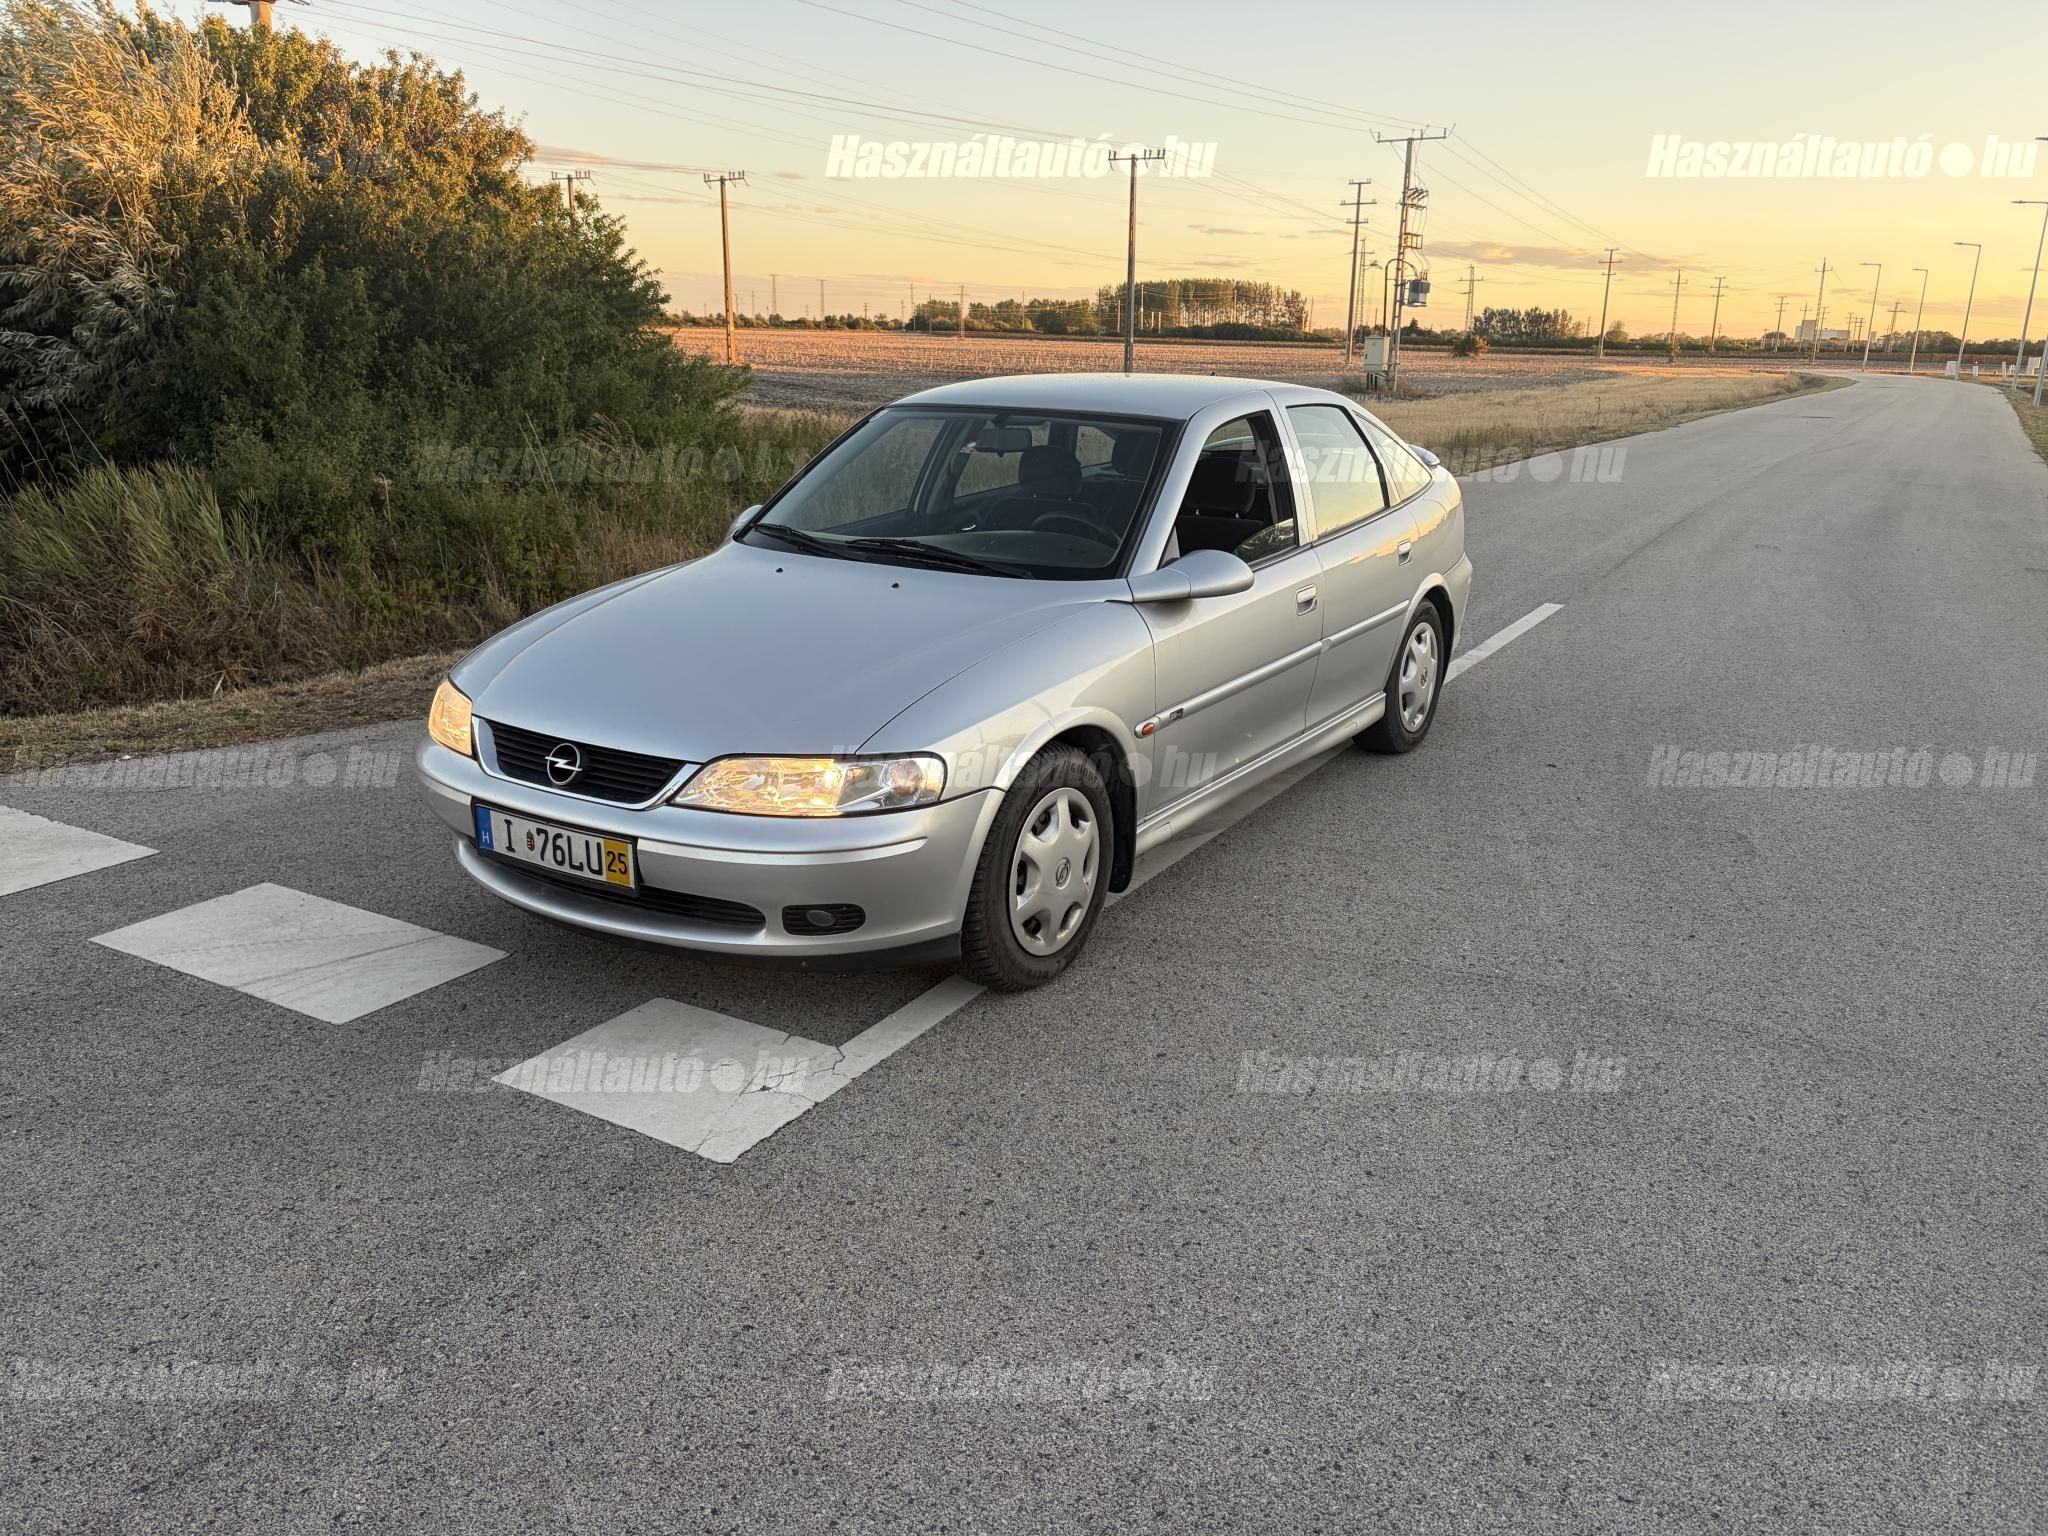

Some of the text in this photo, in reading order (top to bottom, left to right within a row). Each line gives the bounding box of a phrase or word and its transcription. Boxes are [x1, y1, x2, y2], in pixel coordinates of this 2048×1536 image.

[482, 830, 490, 844] H
[536, 827, 603, 876] 76LU
[606, 850, 628, 875] 25
